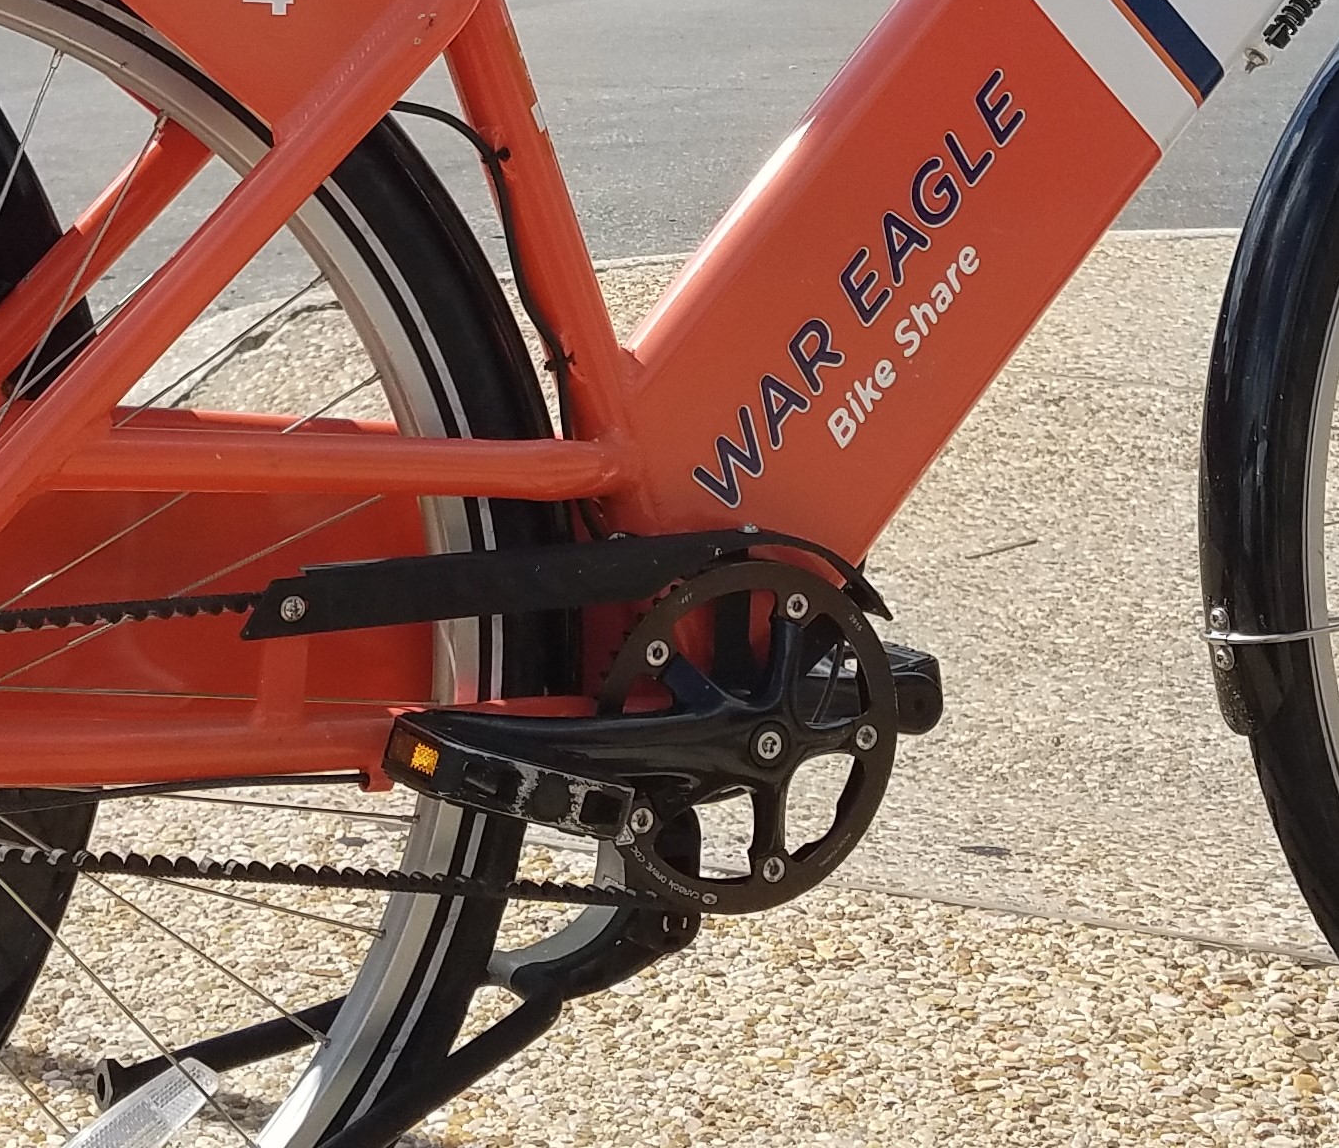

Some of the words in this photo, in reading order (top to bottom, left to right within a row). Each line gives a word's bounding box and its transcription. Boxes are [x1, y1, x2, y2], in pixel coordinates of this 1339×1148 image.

[692, 318, 846, 509] WAR
[838, 68, 1027, 327] EAGLE
[827, 359, 898, 449] Bike
[893, 245, 981, 357] Share
